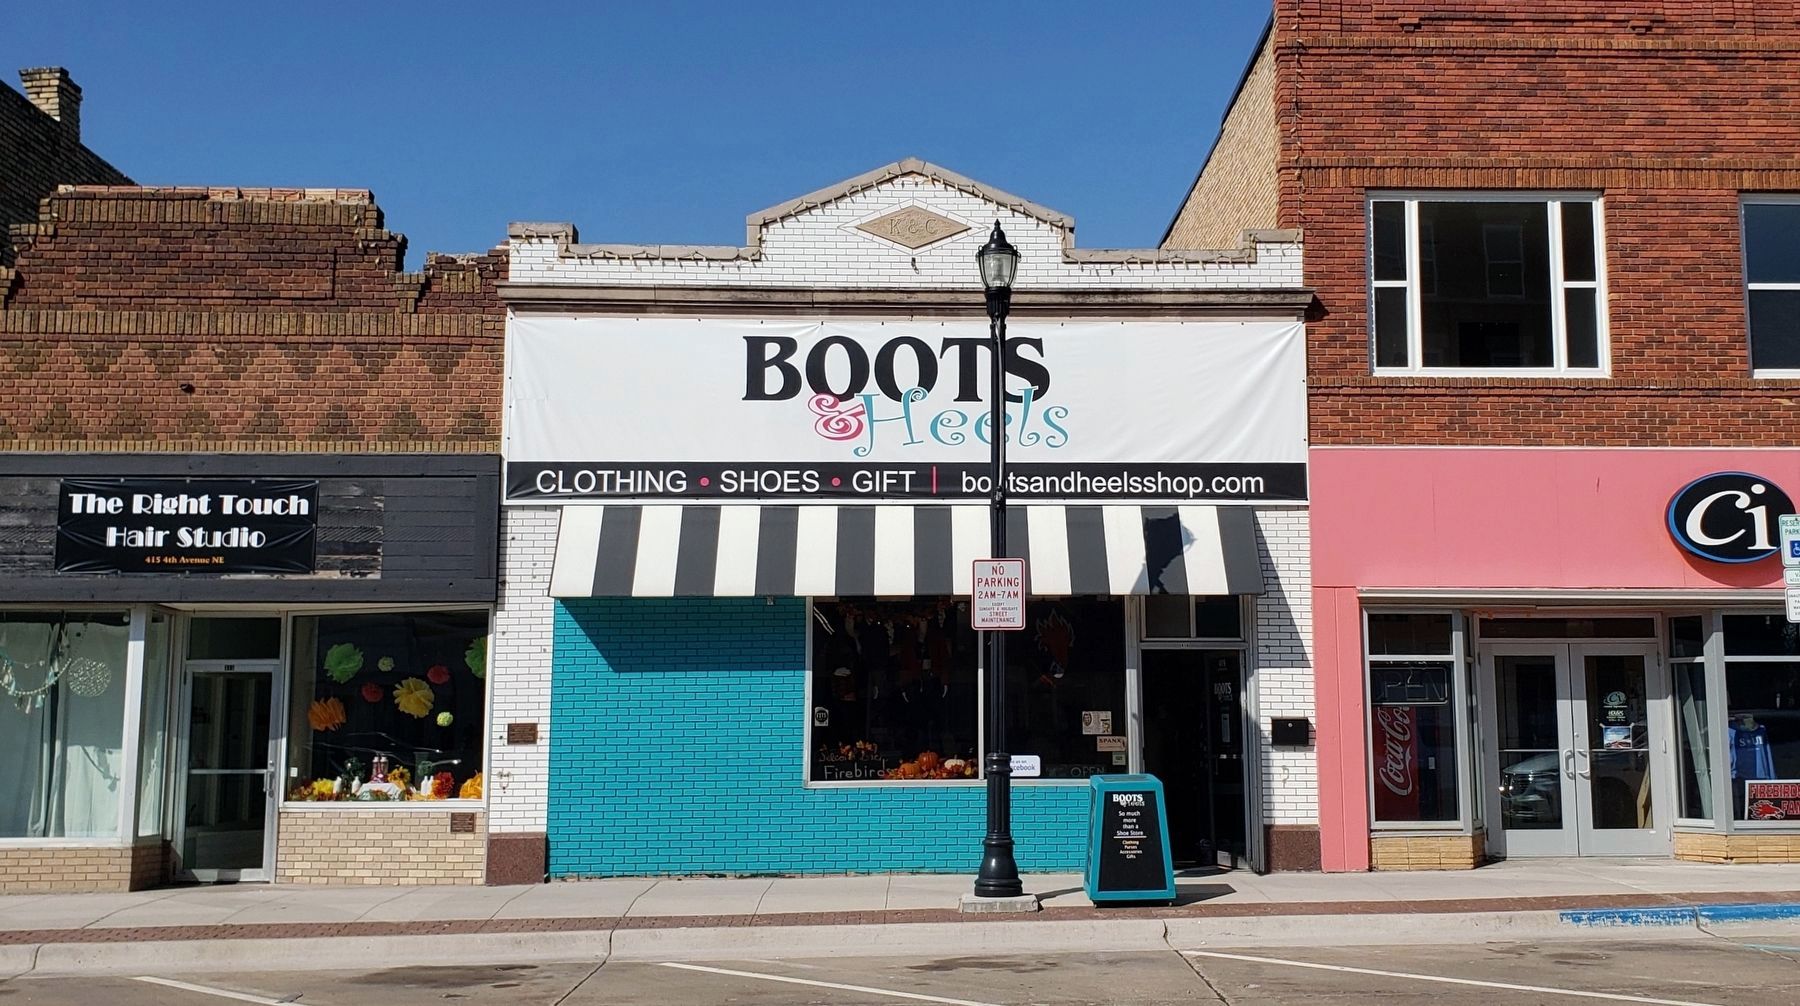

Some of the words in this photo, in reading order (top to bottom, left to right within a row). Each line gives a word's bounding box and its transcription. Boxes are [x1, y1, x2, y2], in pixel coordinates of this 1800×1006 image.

[889, 218, 902, 234] K
[925, 218, 938, 234] C
[741, 335, 1050, 403] BOOTS
[807, 393, 867, 441] &
[853, 386, 1070, 457] Heels
[535, 469, 687, 493] CLOTHING
[719, 469, 820, 493] SHOES
[851, 469, 917, 493] GIFT
[961, 470, 1264, 498] botsandheelsshop.com
[68, 493, 123, 514] The
[132, 493, 212, 516] Right
[218, 494, 309, 516] Touch
[1685, 483, 1778, 550] Ci
[105, 526, 171, 548] Hair
[176, 526, 266, 548] Studio
[144, 556, 161, 564] 415
[162, 556, 178, 564] 4th
[179, 556, 211, 564] Avenue
[211, 556, 225, 564] NE
[991, 565, 1005, 576] NO
[977, 577, 1020, 588] PARKING
[978, 590, 1019, 600] 2AM-7AM
[1013, 763, 1035, 771] cebook
[1112, 793, 1144, 803] BOOTS
